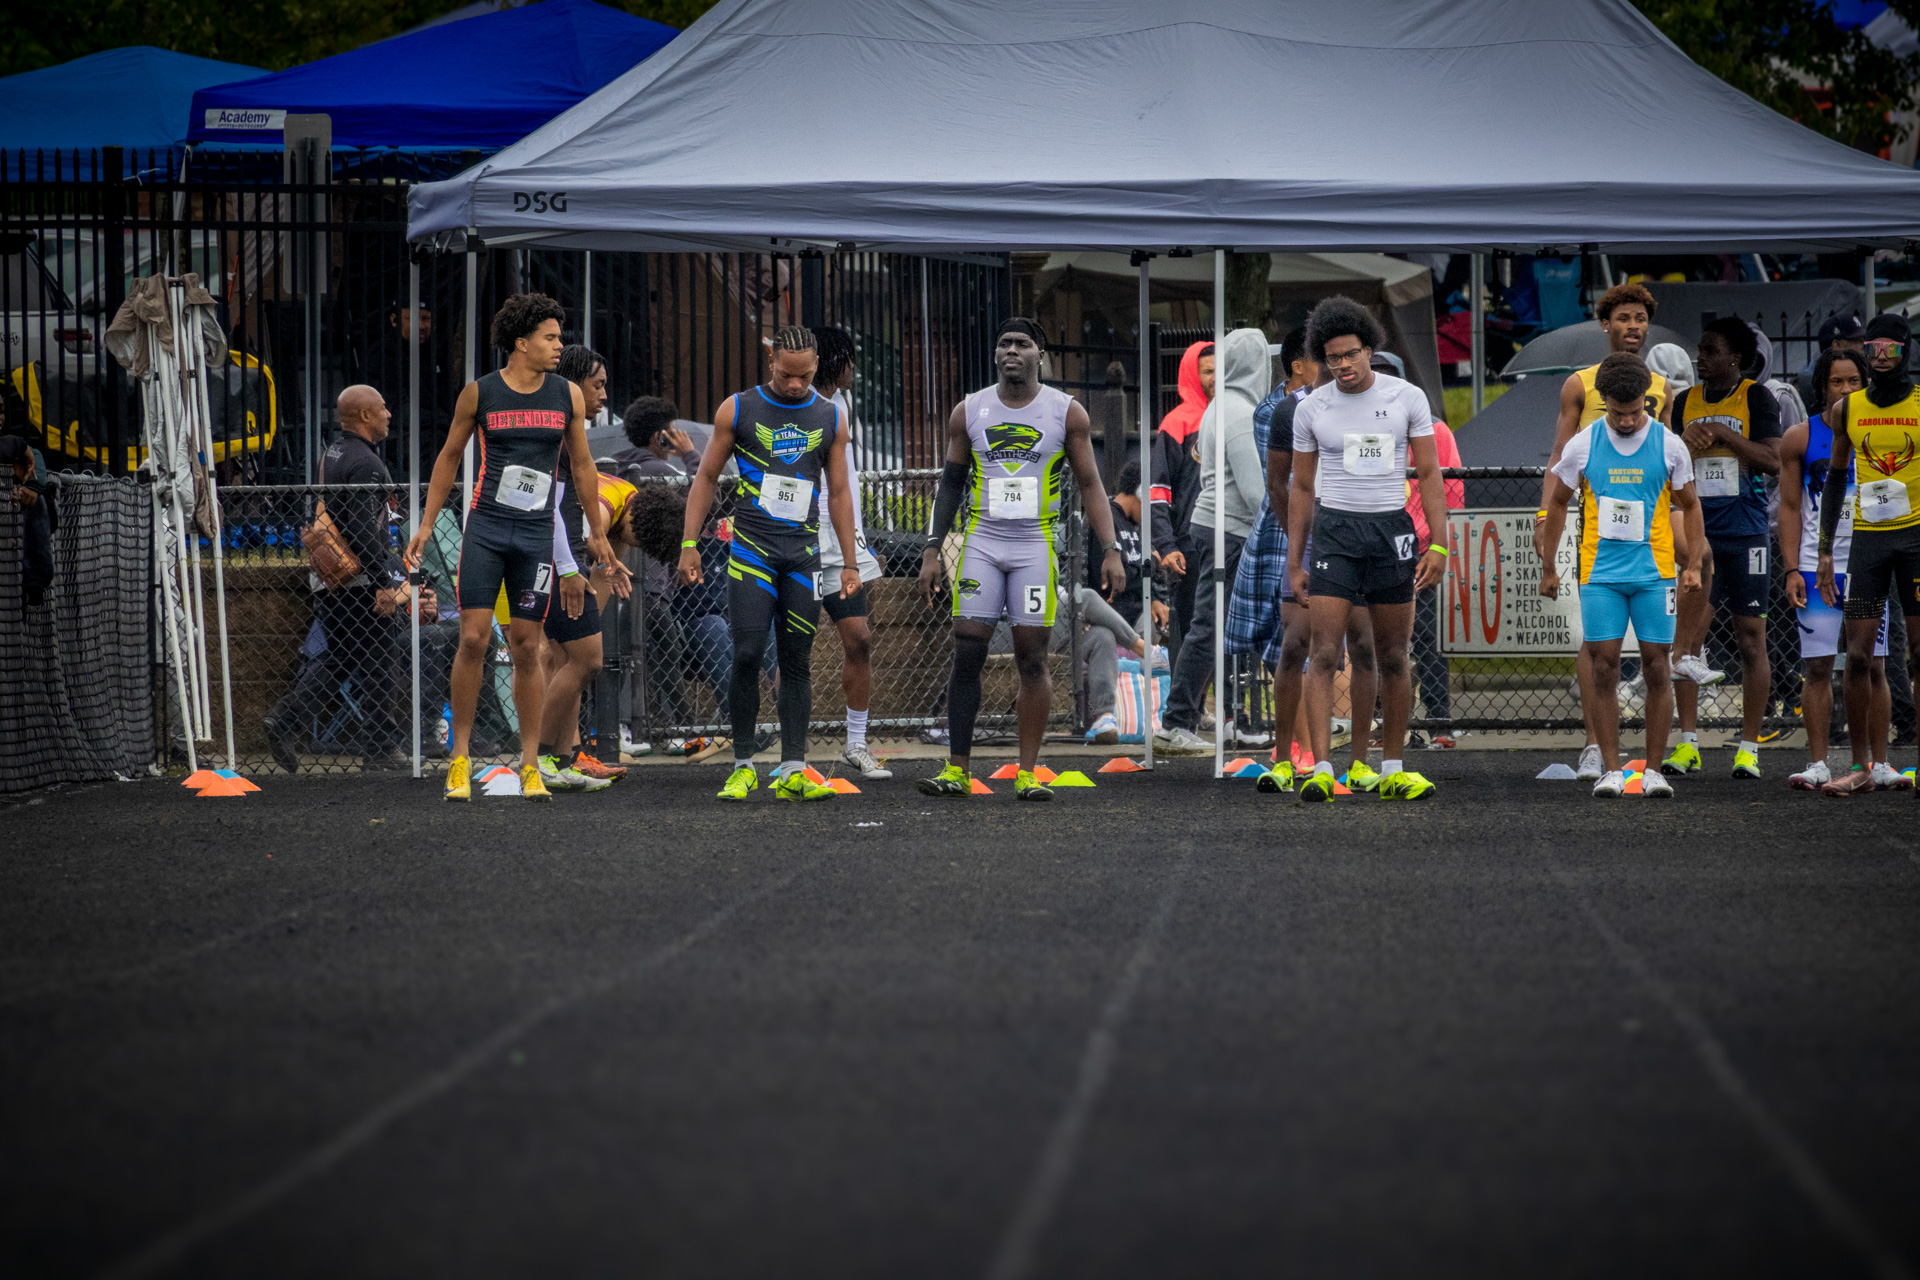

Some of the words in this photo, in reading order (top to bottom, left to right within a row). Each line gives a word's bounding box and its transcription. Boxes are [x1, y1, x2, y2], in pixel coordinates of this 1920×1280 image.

[219, 111, 270, 127] Academy
[513, 191, 567, 213] DSG
[486, 409, 565, 430] DEFENDERS
[1857, 417, 1894, 427] CAROLINA
[1896, 417, 1918, 427] BLAZE
[780, 431, 797, 439] TEAM
[987, 450, 1039, 462] PANTHERS
[1359, 448, 1381, 458] 1265
[1610, 476, 1643, 484] EAGLES
[1705, 470, 1725, 480] 1231
[517, 481, 535, 494] 706
[778, 490, 795, 502] 951
[1004, 492, 1022, 502] 794
[1877, 494, 1889, 505] 36
[1612, 513, 1630, 524] 343
[1839, 510, 1850, 520] 29
[1515, 551, 1571, 565] BICES
[1754, 549, 1763, 573] 1
[540, 565, 551, 591] 7
[1449, 520, 1502, 645] NO
[1515, 583, 1571, 597] VEHES
[1029, 587, 1042, 613] 5
[1515, 600, 1542, 613] PETS
[1515, 615, 1570, 629] ALCOHOL
[1515, 631, 1571, 645] WEAPONS
